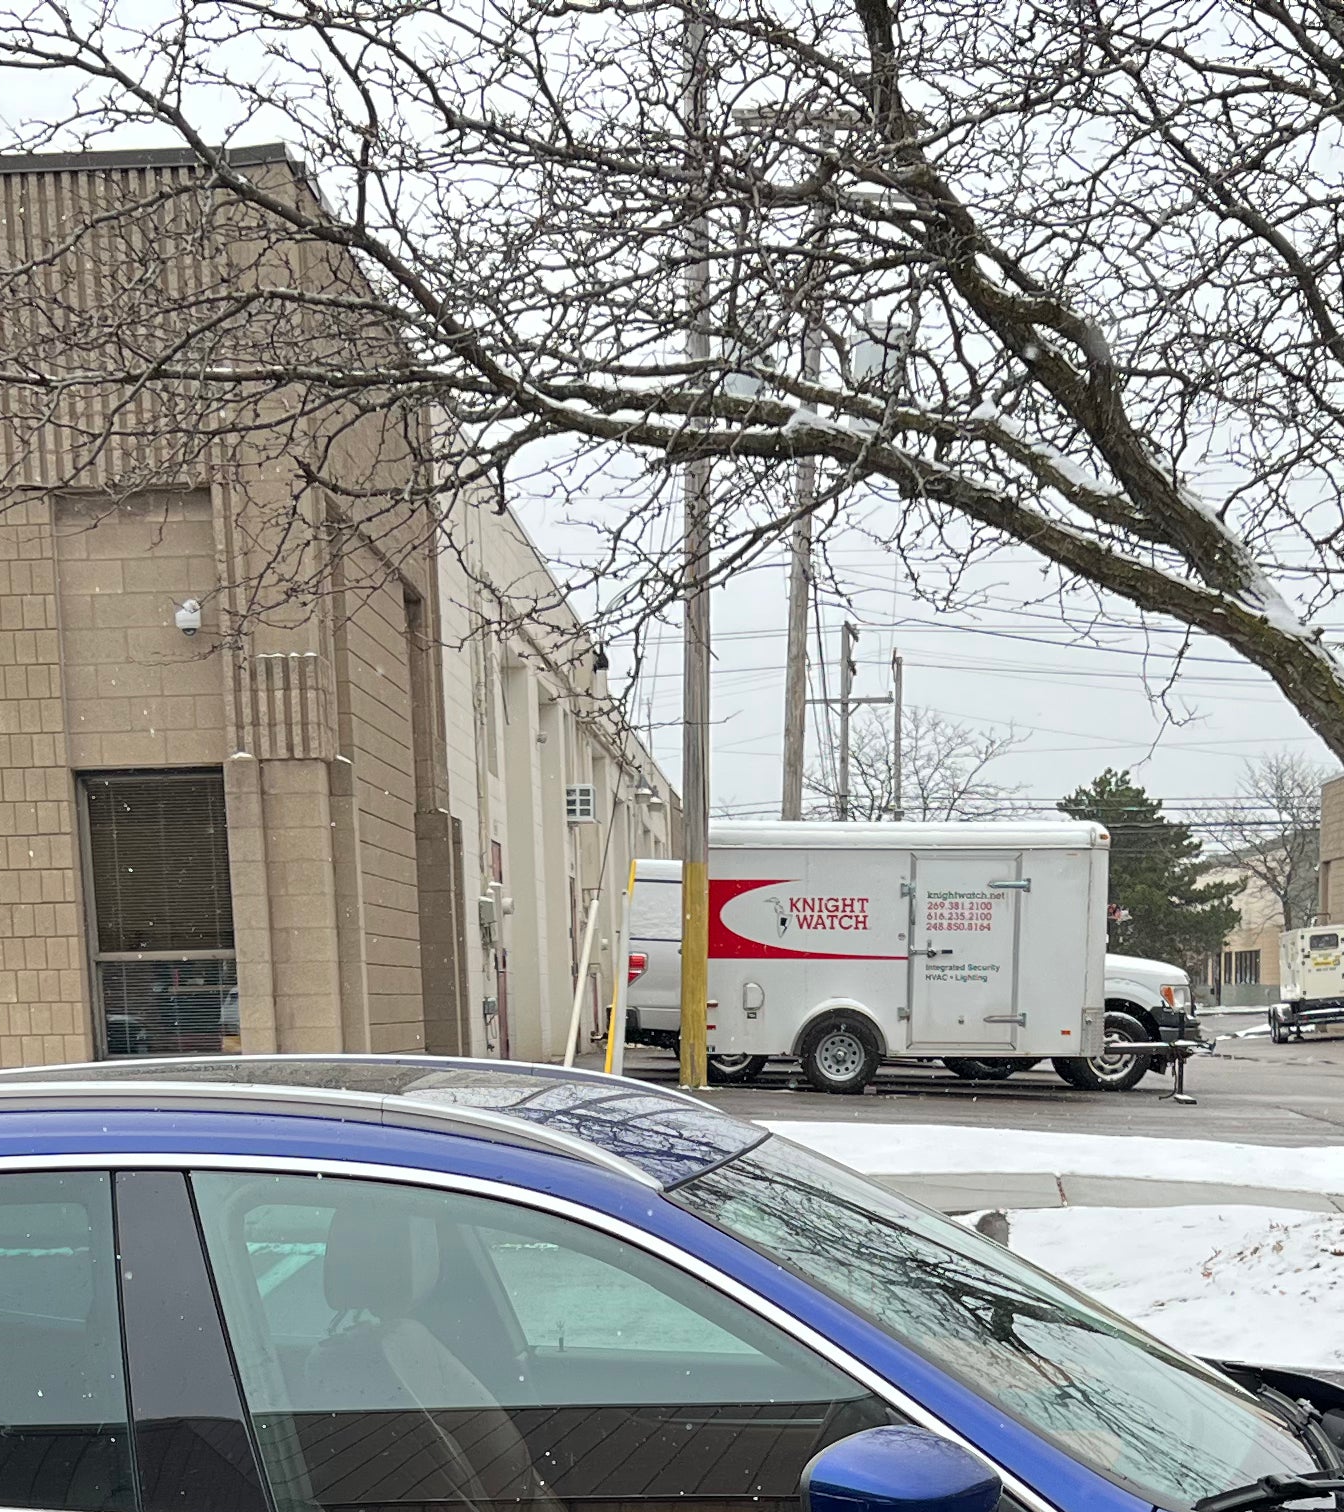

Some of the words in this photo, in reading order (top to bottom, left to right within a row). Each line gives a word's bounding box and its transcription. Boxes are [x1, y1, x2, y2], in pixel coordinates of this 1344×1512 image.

[927, 891, 1005, 900] knightwatch.net
[789, 897, 869, 914] KNIGHT
[927, 901, 993, 911] 269.381.2100
[926, 912, 993, 921] 616.235.2100
[796, 914, 869, 930] WATCH
[925, 964, 966, 972] Integrated
[967, 963, 1001, 973] Security
[925, 973, 948, 982] HVAC
[955, 973, 988, 983] Lighting
